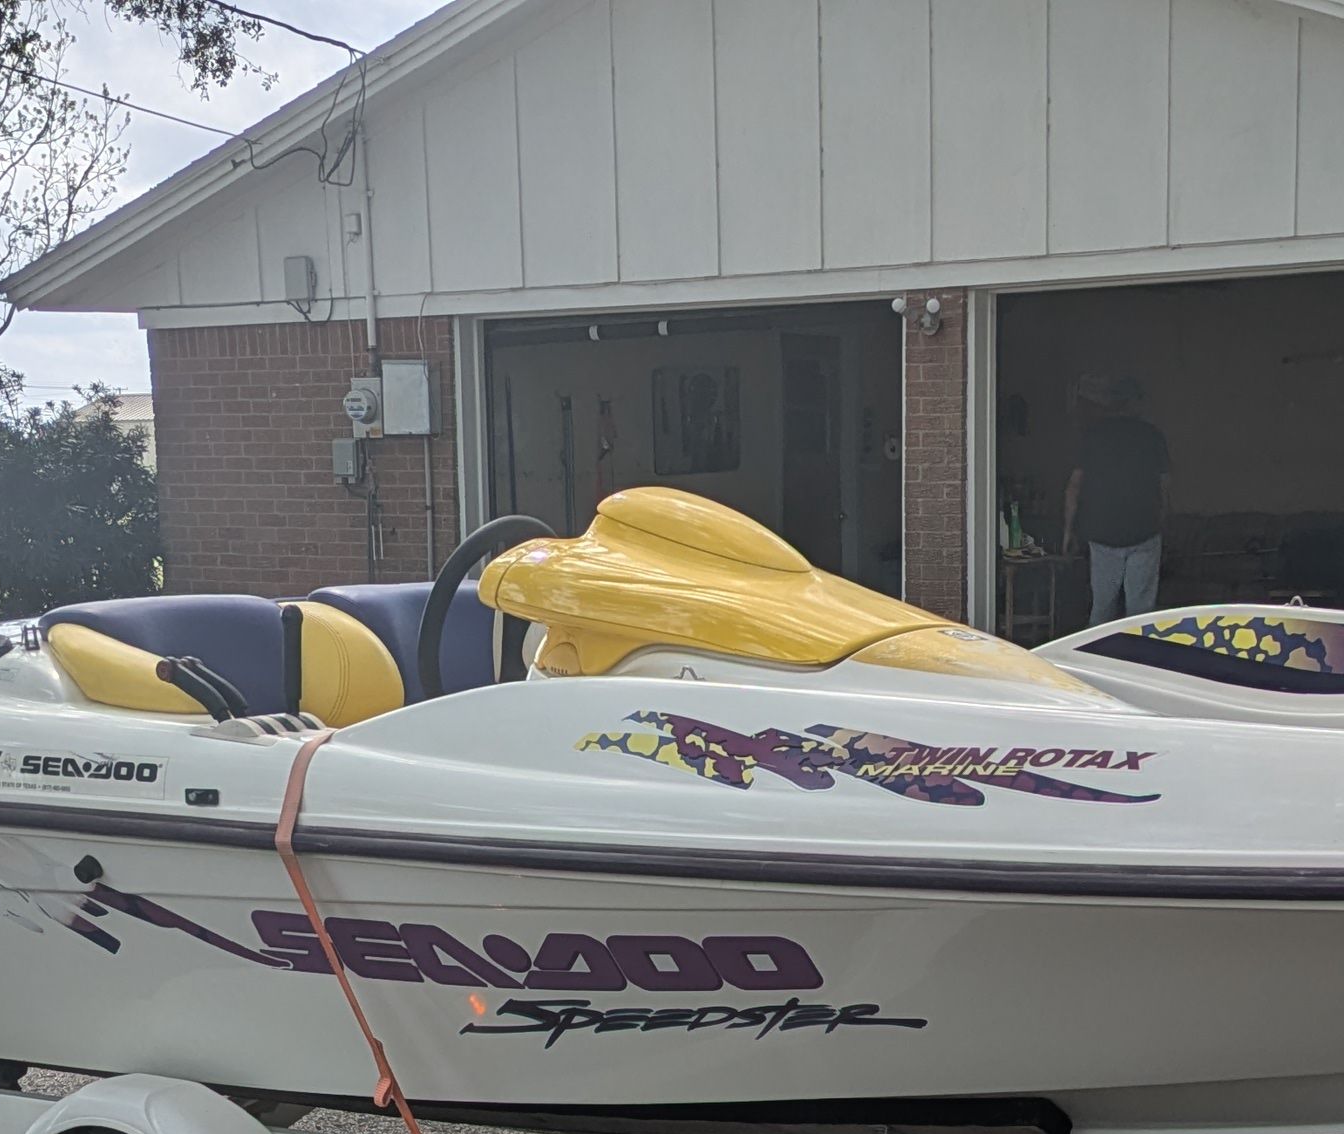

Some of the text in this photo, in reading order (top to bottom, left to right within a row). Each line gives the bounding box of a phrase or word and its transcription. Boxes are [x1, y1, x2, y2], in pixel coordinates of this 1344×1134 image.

[889, 747, 1160, 771] TWIN ROTAX
[856, 764, 1026, 777] MARINE
